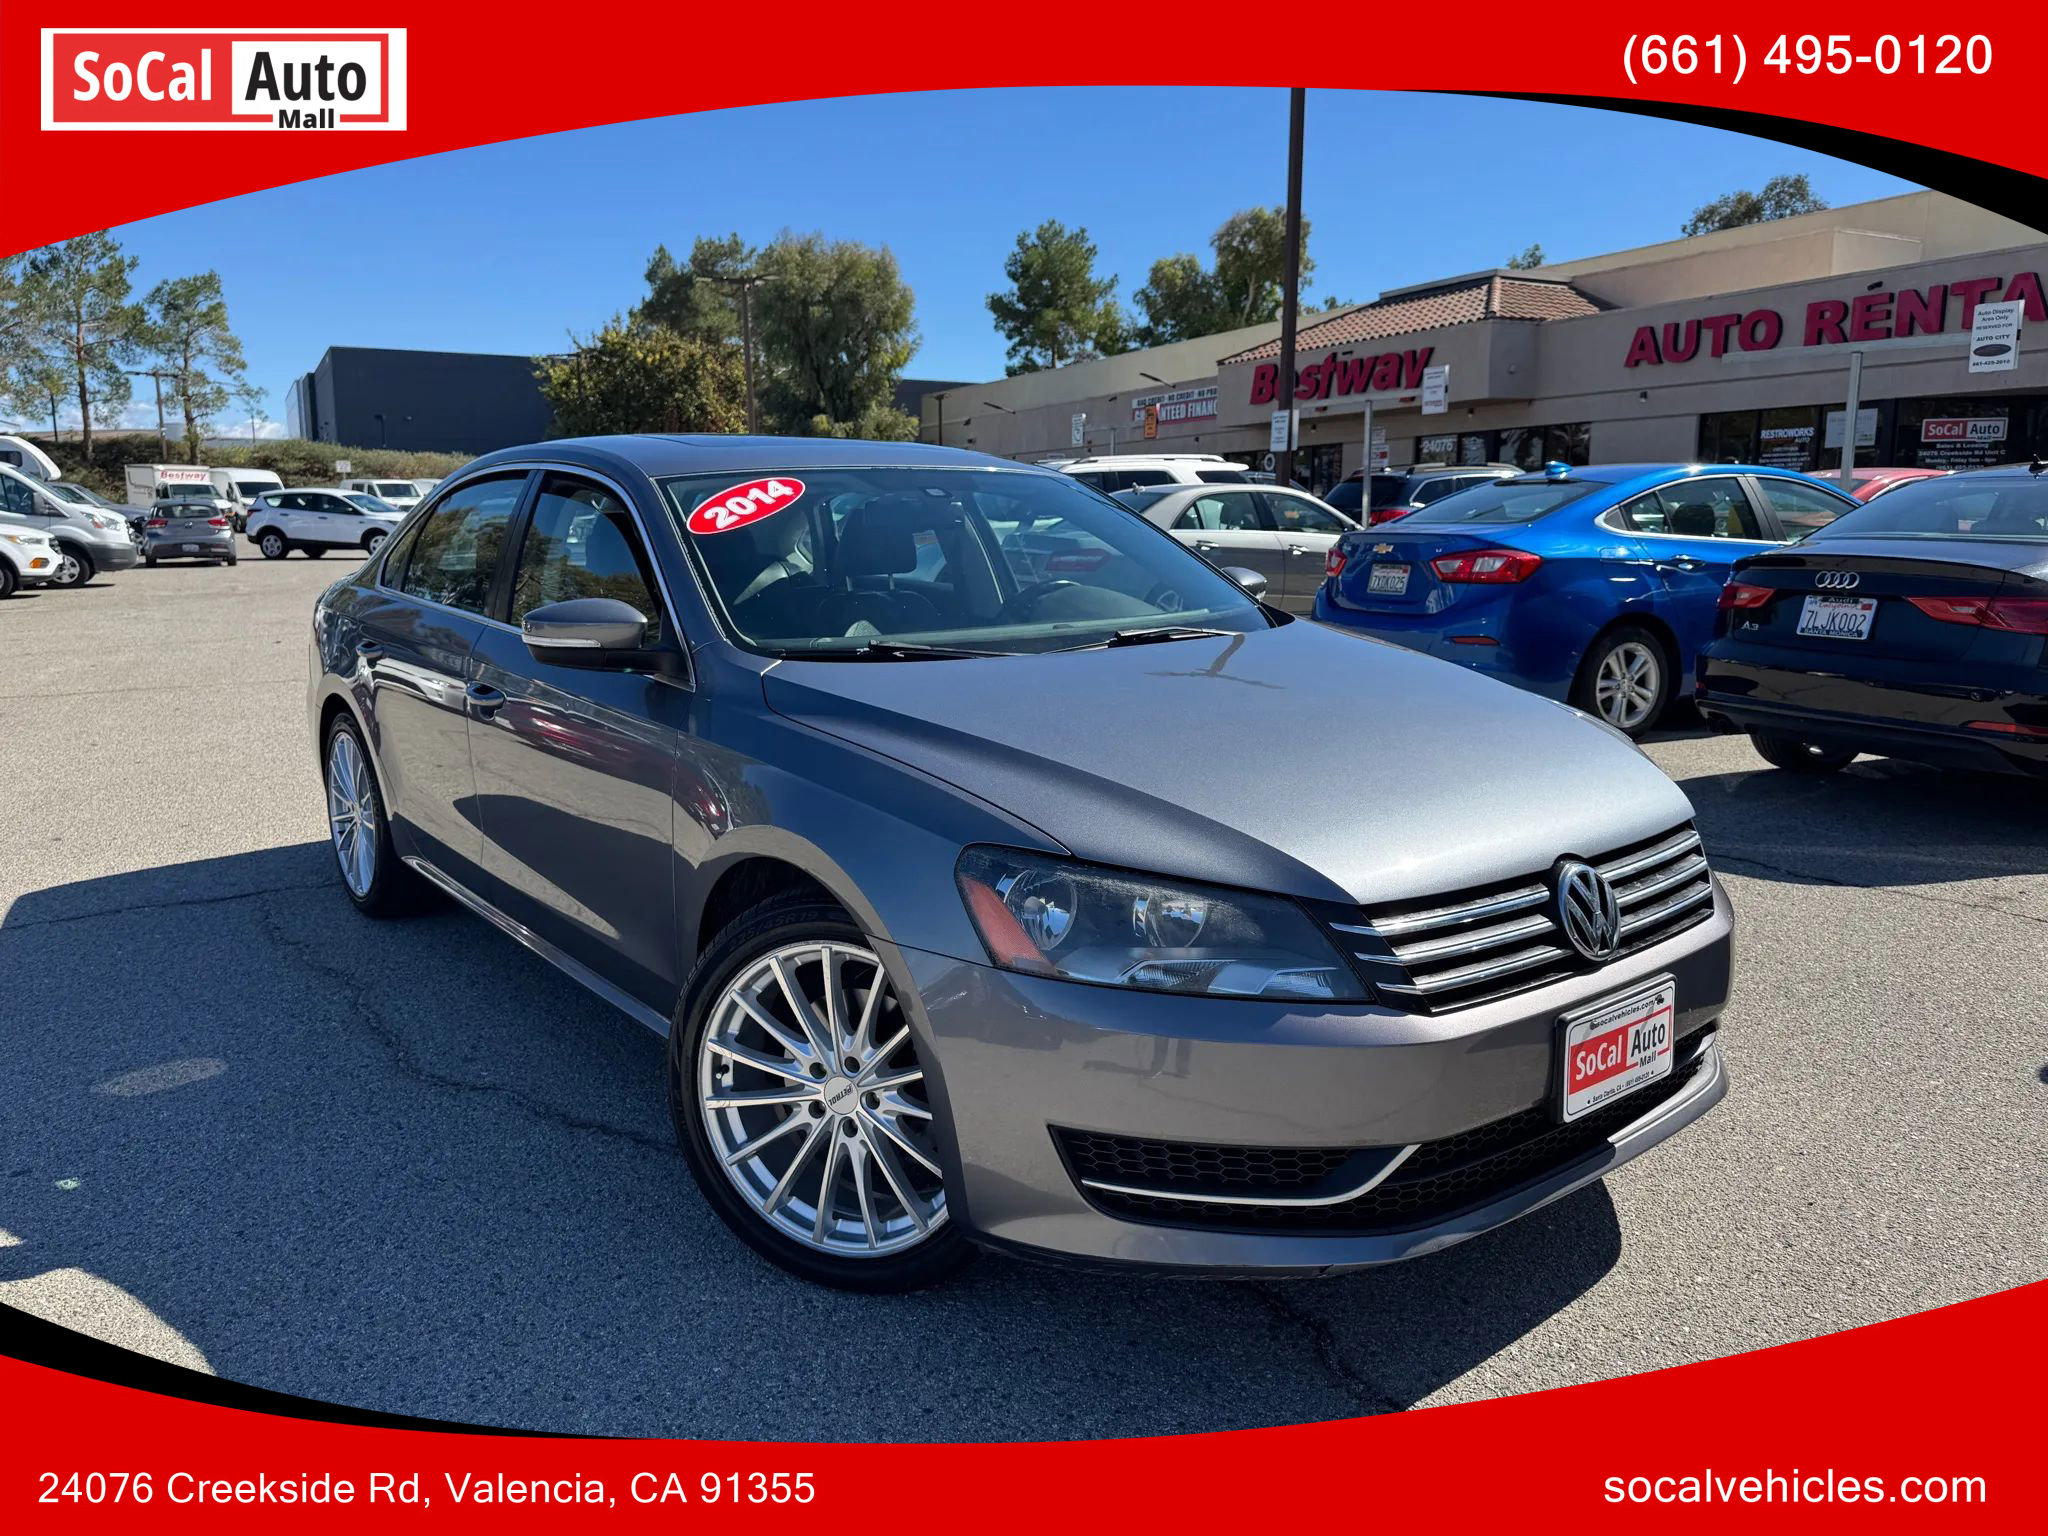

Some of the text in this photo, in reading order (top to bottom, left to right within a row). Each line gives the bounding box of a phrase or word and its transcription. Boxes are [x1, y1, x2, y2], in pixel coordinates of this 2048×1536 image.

[1992, 307, 2014, 315] Display
[1624, 309, 1784, 368] AUTO
[1760, 427, 1815, 439] RESTROWORKS
[1928, 422, 2000, 436] SoCal Auto
[1422, 438, 1453, 453] 24076
[160, 469, 207, 481] Bestway
[703, 480, 795, 530] 2014
[1818, 602, 1858, 611] California
[1741, 620, 1760, 631] A3
[1805, 609, 1867, 633] 7LJK002
[1804, 628, 1858, 638] SANTA MONICA
[1597, 999, 1655, 1027] socalvehicles.com
[1575, 1023, 1666, 1081] SoCal Auto
[1639, 1050, 1657, 1068] Mall
[828, 1084, 853, 1106] PETROL
